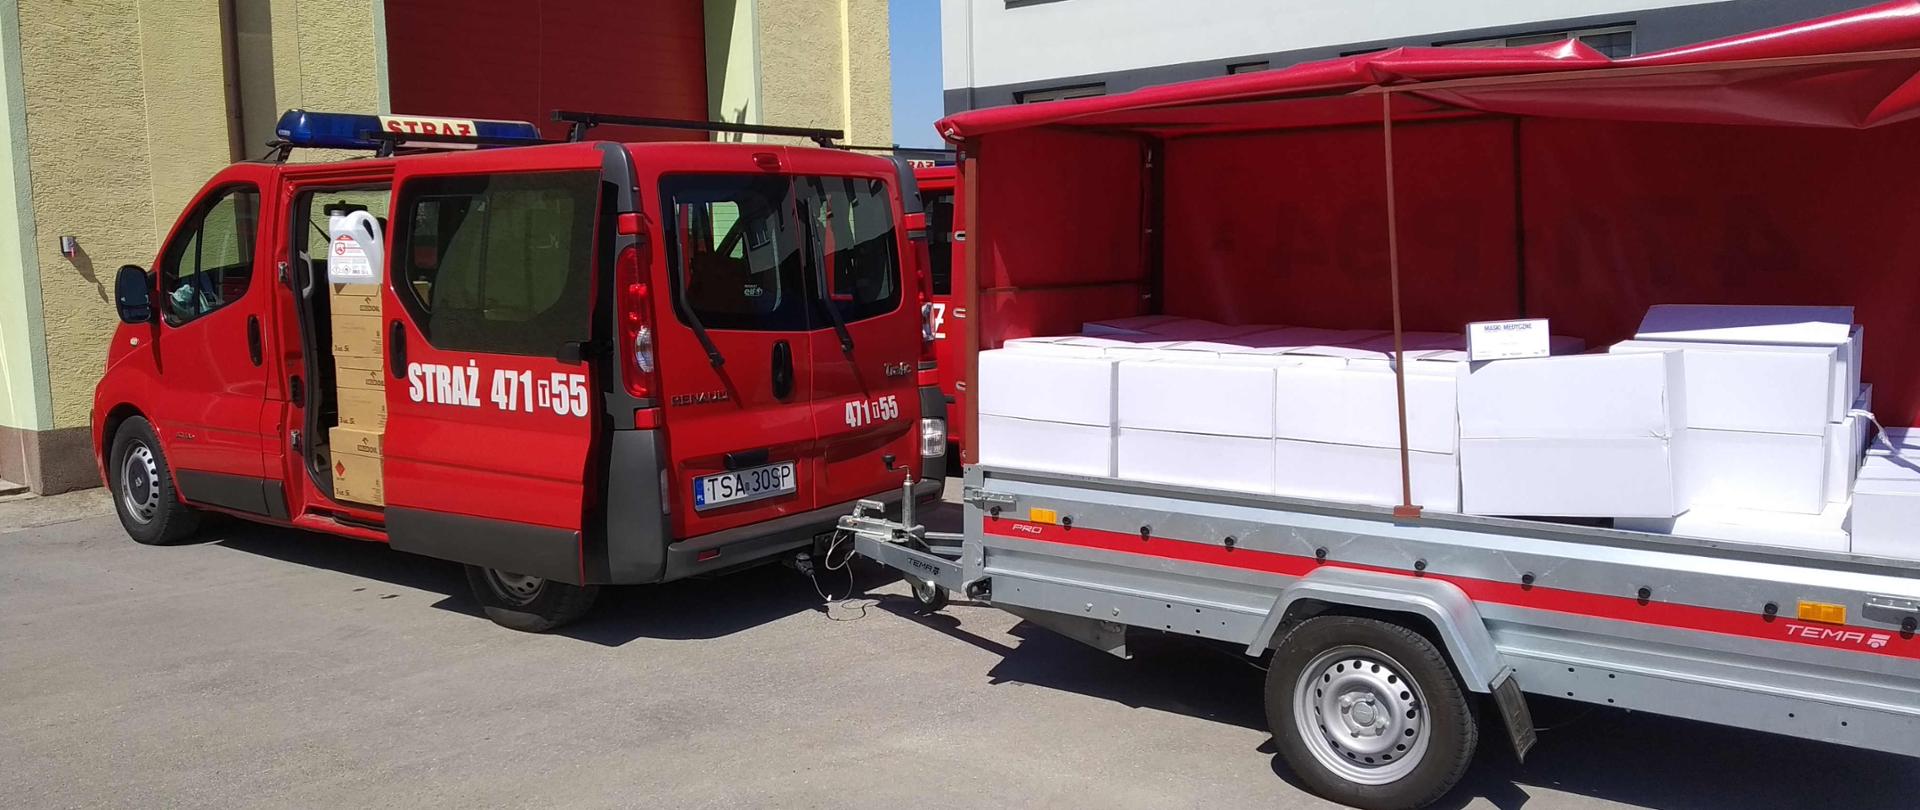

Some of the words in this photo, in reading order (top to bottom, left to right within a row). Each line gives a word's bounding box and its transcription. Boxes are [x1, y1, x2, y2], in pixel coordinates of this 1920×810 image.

[407, 359, 481, 407] STRAŻ
[707, 474, 746, 501] TSA
[1012, 523, 1043, 534] PRO
[908, 557, 933, 573] TEMA
[1785, 624, 1865, 644] TEMA
